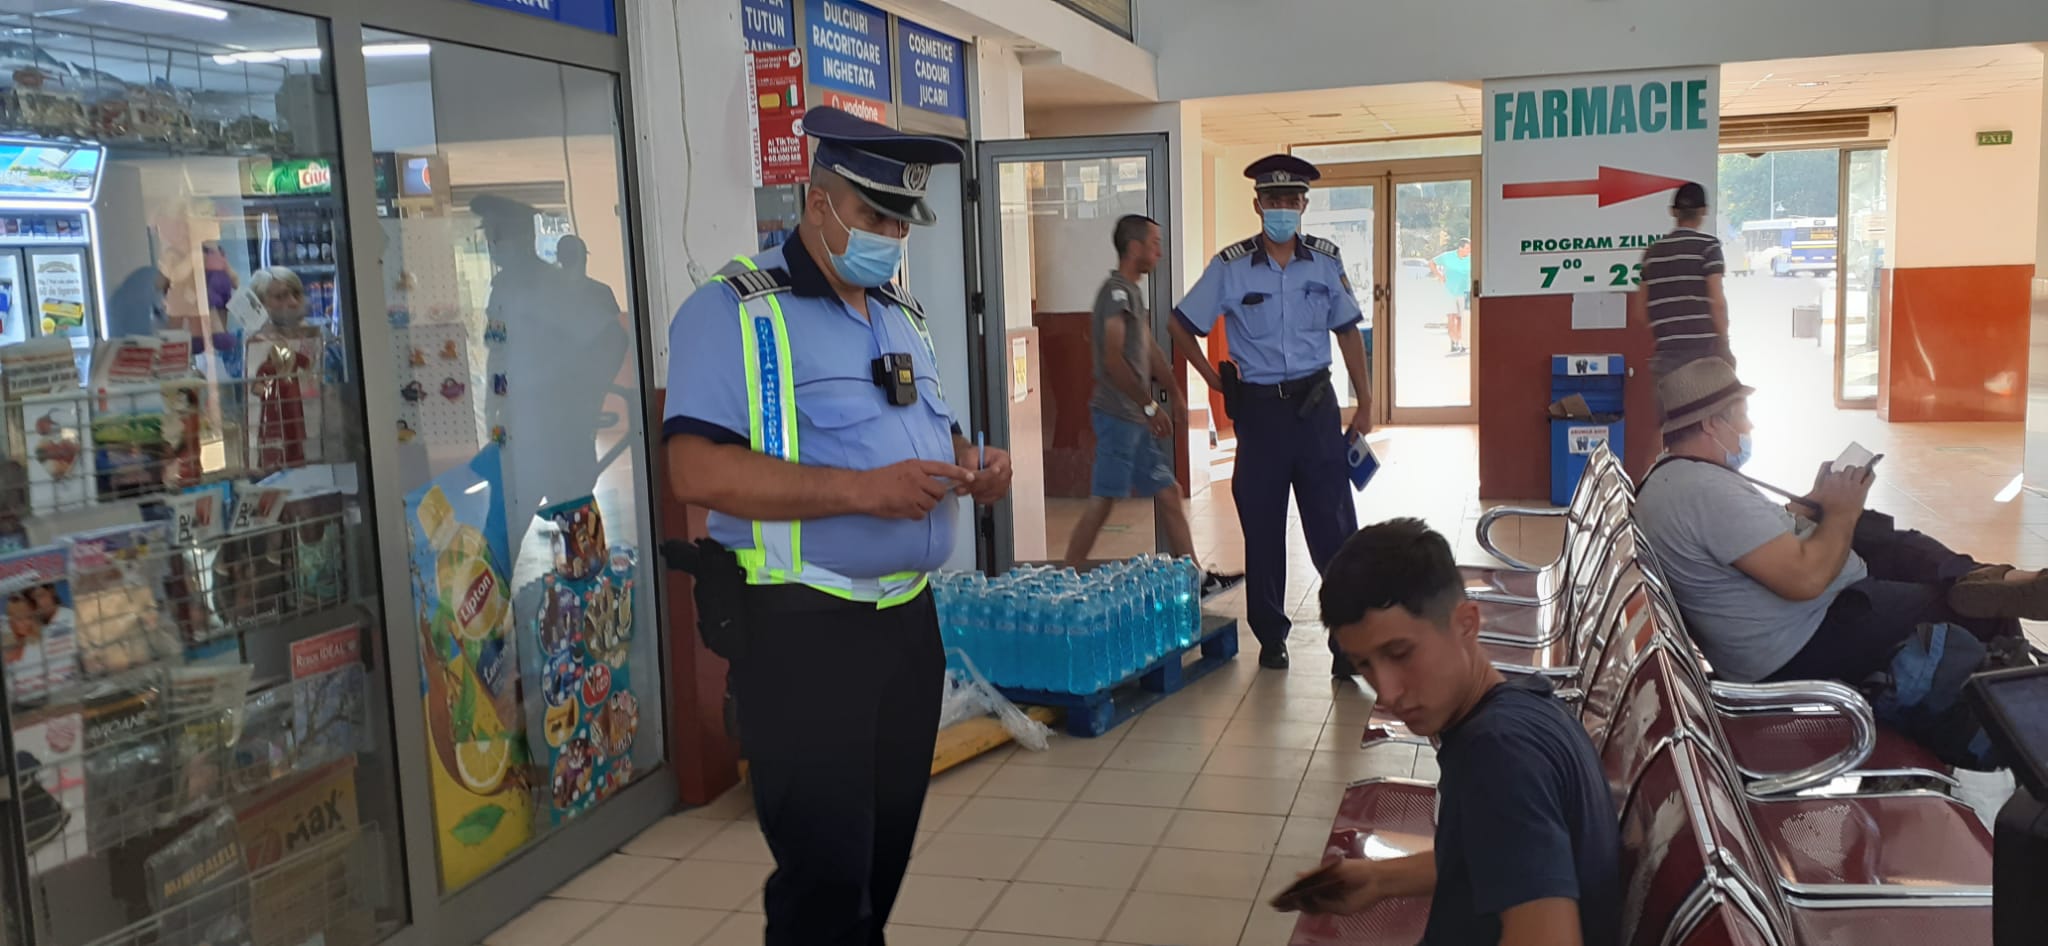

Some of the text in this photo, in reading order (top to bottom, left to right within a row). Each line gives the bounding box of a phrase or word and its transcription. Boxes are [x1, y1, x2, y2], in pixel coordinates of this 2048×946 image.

[744, 5, 785, 38] TUTUN
[823, 1, 868, 35] DULCIURI
[812, 24, 881, 65] RACORITOARE
[908, 33, 953, 63] COSMETICE
[822, 56, 876, 90] INGHETATA
[914, 58, 950, 86] CADOURI
[843, 98, 879, 121] vodafone
[919, 84, 949, 108] JUCARII
[1494, 80, 1708, 142] FARMACIE
[1981, 133, 2010, 144] EXIT
[1521, 237, 1613, 252] PROGRAM
[461, 574, 492, 622] Lipton
